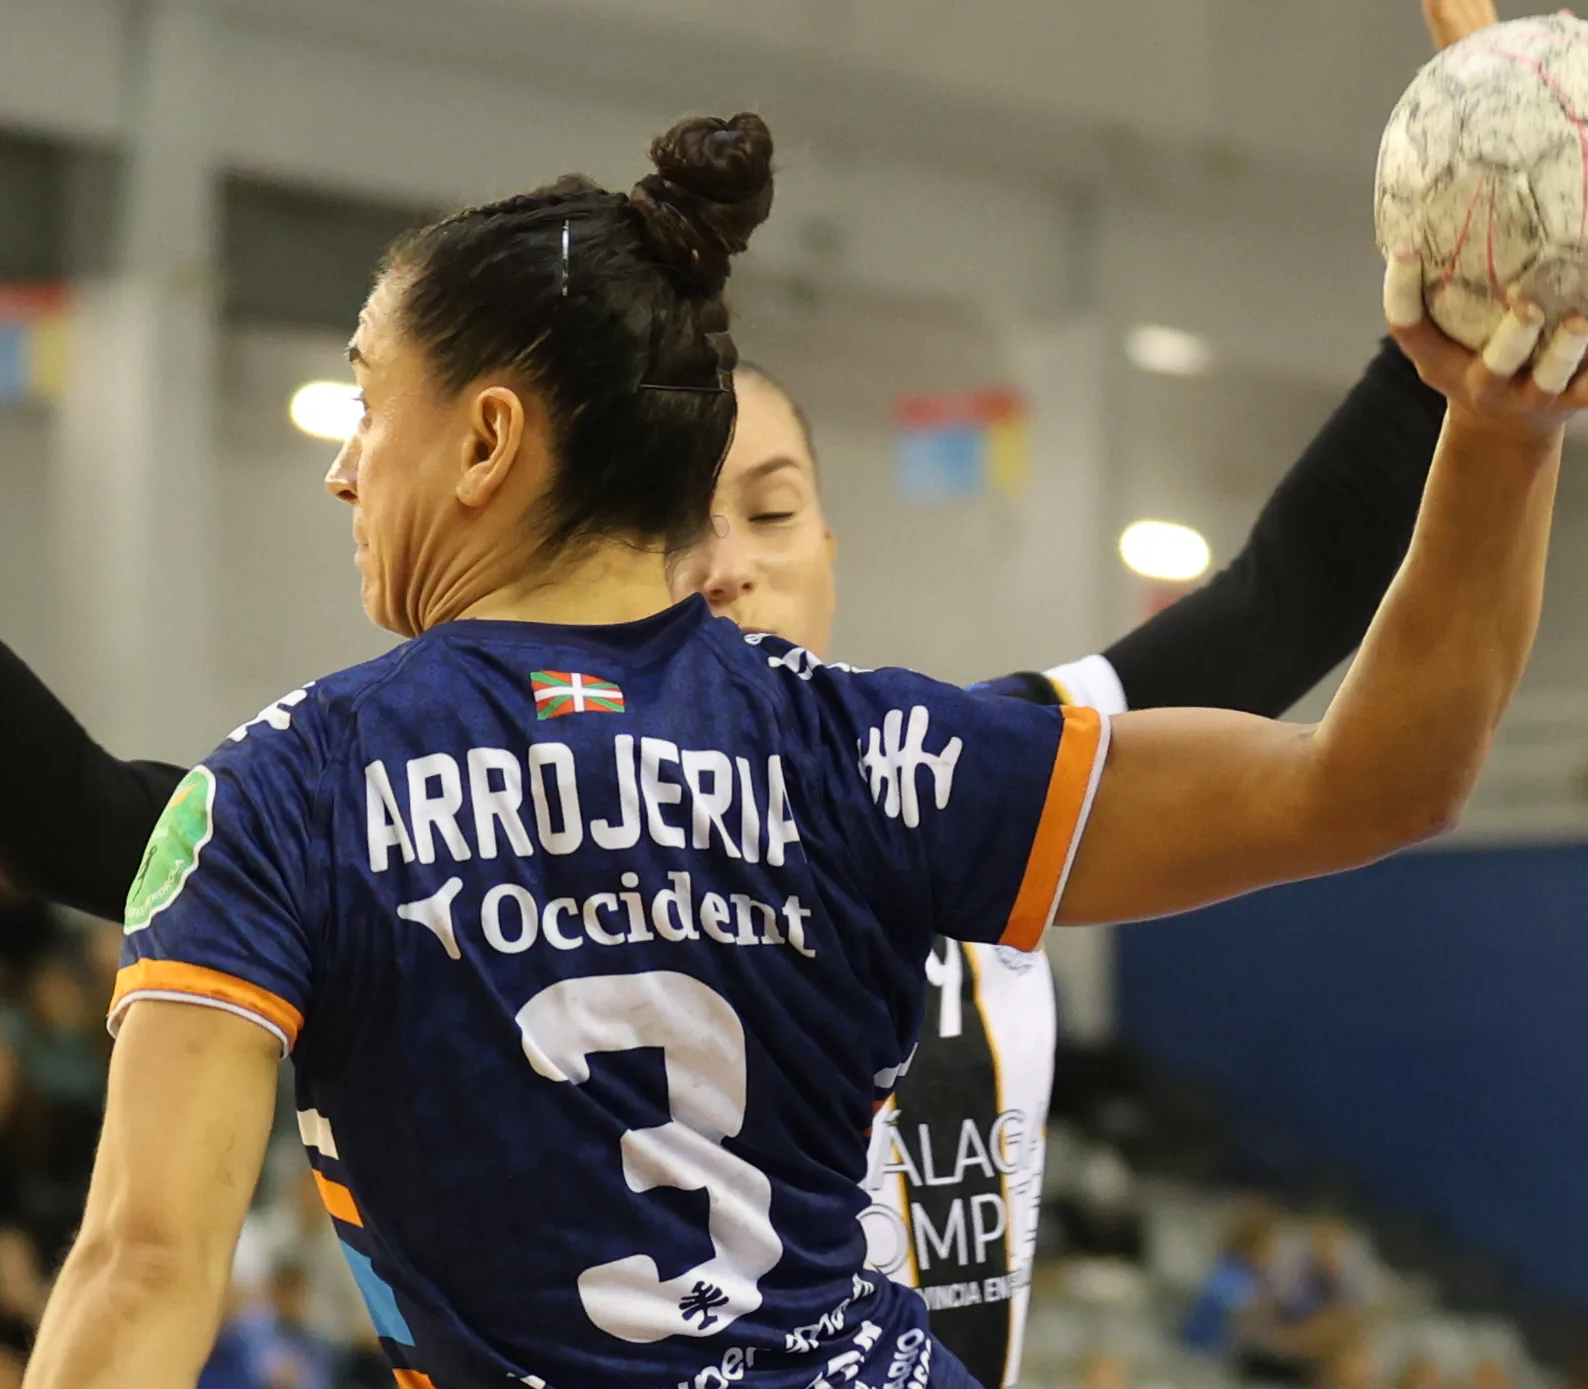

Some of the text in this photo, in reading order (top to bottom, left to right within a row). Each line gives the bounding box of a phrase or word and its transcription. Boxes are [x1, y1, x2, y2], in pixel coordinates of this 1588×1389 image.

[364, 733, 807, 874] ARROJERIA
[479, 871, 816, 958] Occident
[515, 970, 783, 1342] 3
[859, 1108, 1042, 1192] ÁLAG
